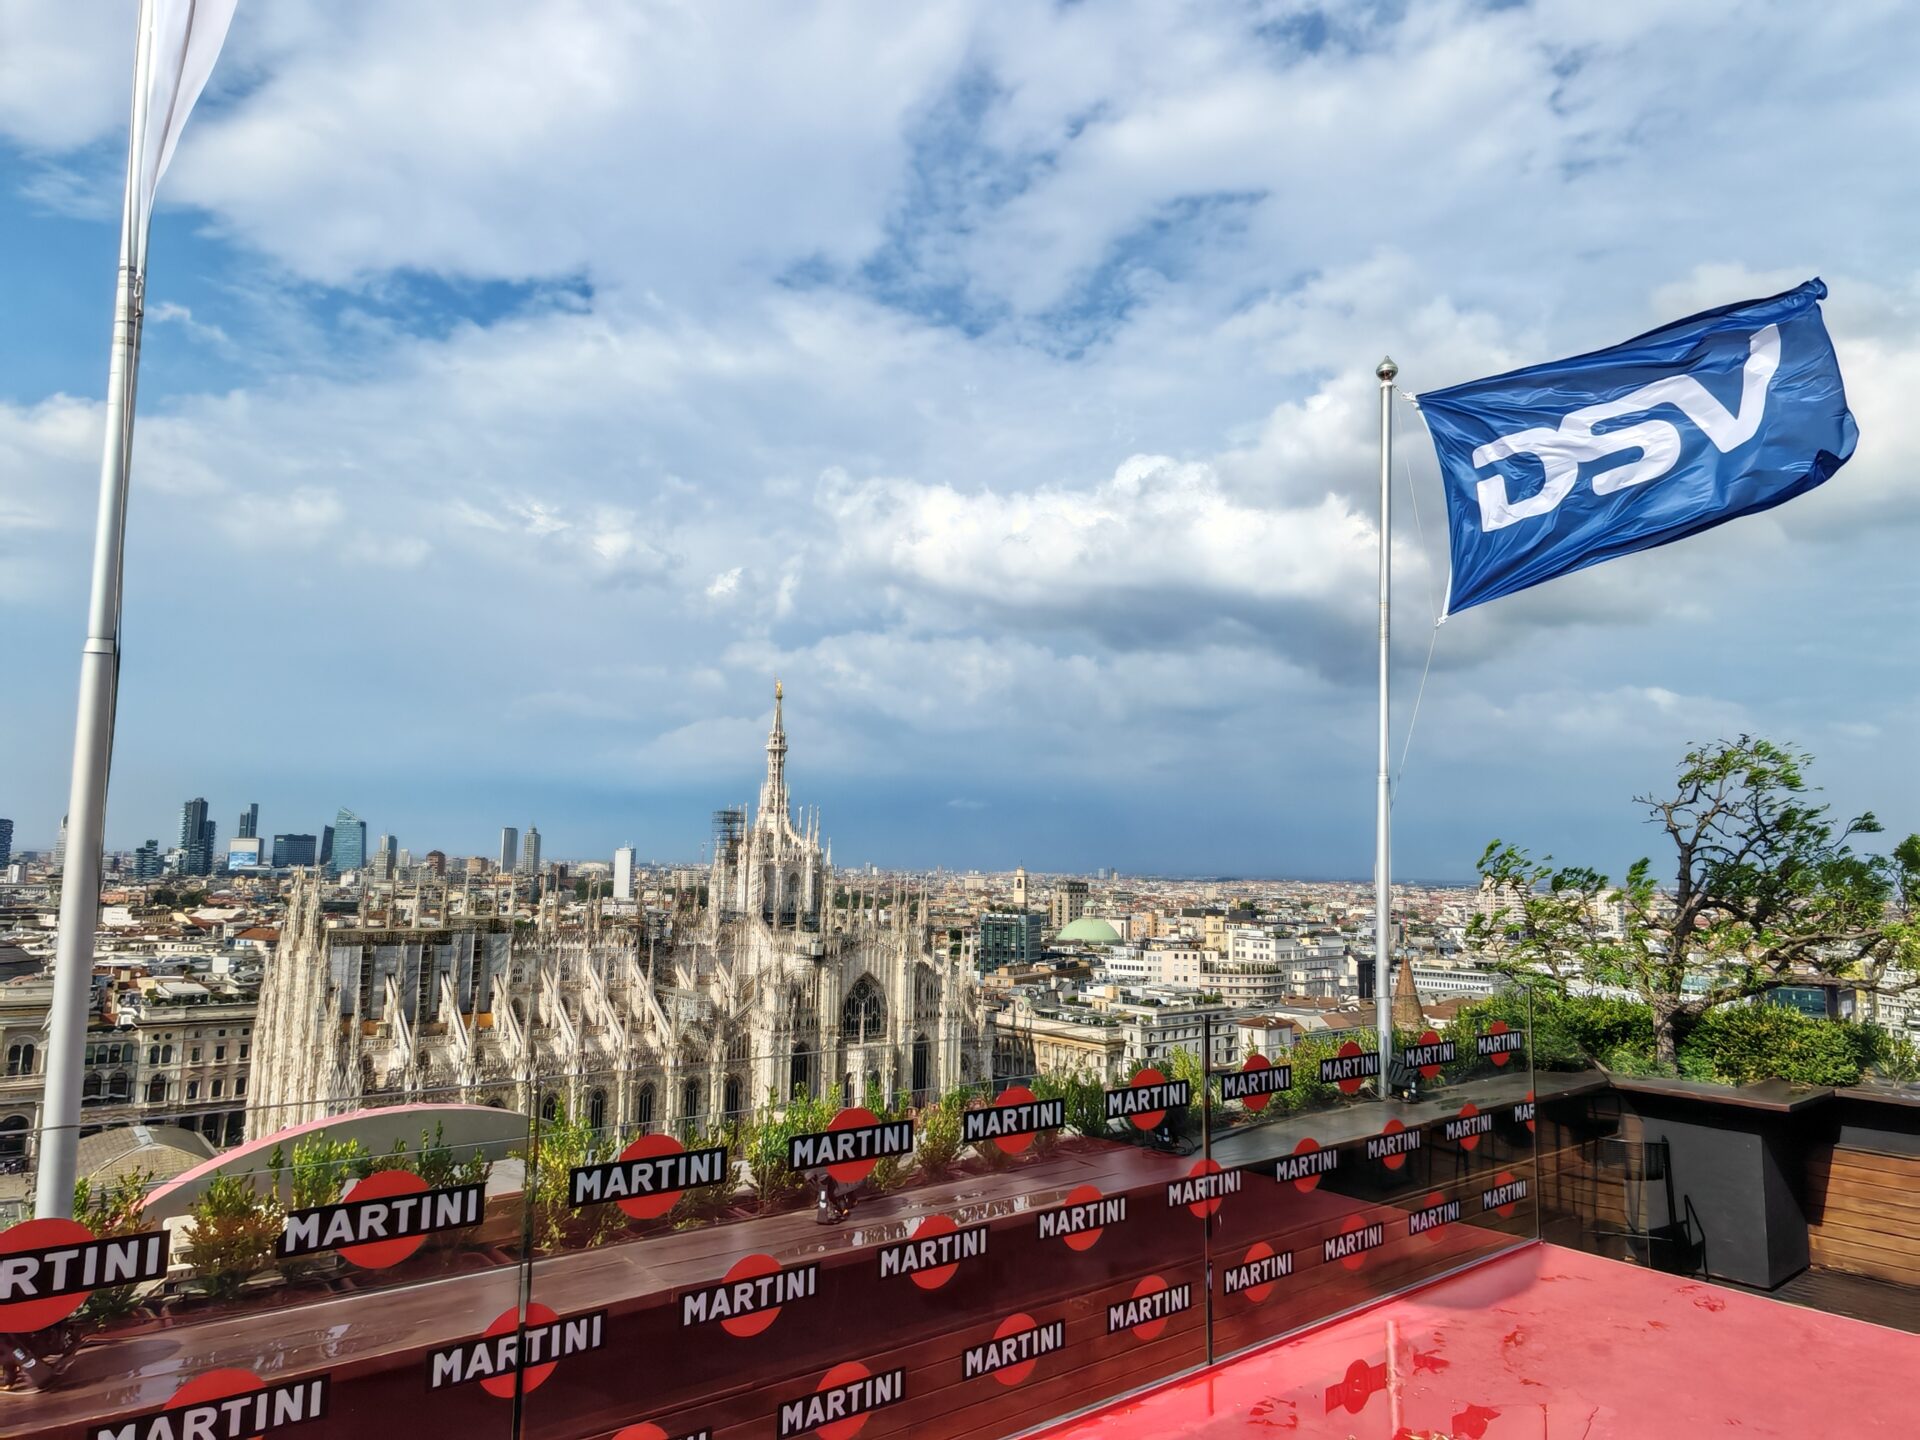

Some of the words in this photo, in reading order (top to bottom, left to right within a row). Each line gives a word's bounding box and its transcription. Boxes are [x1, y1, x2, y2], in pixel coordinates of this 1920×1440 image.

[1472, 323, 1781, 532] DSV
[1406, 1043, 1454, 1068] MARTINI
[1478, 1033, 1521, 1055] MARTINI
[1224, 1068, 1290, 1098] MARTINI
[1322, 1055, 1378, 1081] MARTINI
[1109, 1083, 1187, 1115] MARTINI
[967, 1101, 1062, 1139] MARTINI
[1446, 1115, 1492, 1141] MARTINI
[793, 1125, 909, 1167] MARTINI
[1368, 1131, 1421, 1159] MARTINI
[575, 1152, 722, 1203] MARTINI
[1276, 1150, 1337, 1182] MARTINI
[1169, 1170, 1240, 1206] MARTINI
[1483, 1181, 1527, 1209] MARTINI
[285, 1189, 479, 1251] MARTINI
[1039, 1198, 1126, 1239] MARTINI
[1410, 1202, 1460, 1234] MARTINI
[880, 1229, 986, 1277] MARTINI
[1325, 1225, 1382, 1260] MARTINI
[0, 1237, 160, 1299] RTINI
[1225, 1253, 1292, 1293] MARTINI
[683, 1267, 816, 1326] MARTINI
[1110, 1285, 1189, 1330] MARTINI
[432, 1315, 602, 1388] MARTINI
[966, 1323, 1062, 1377] MARTINI
[782, 1371, 902, 1435] MARTINI
